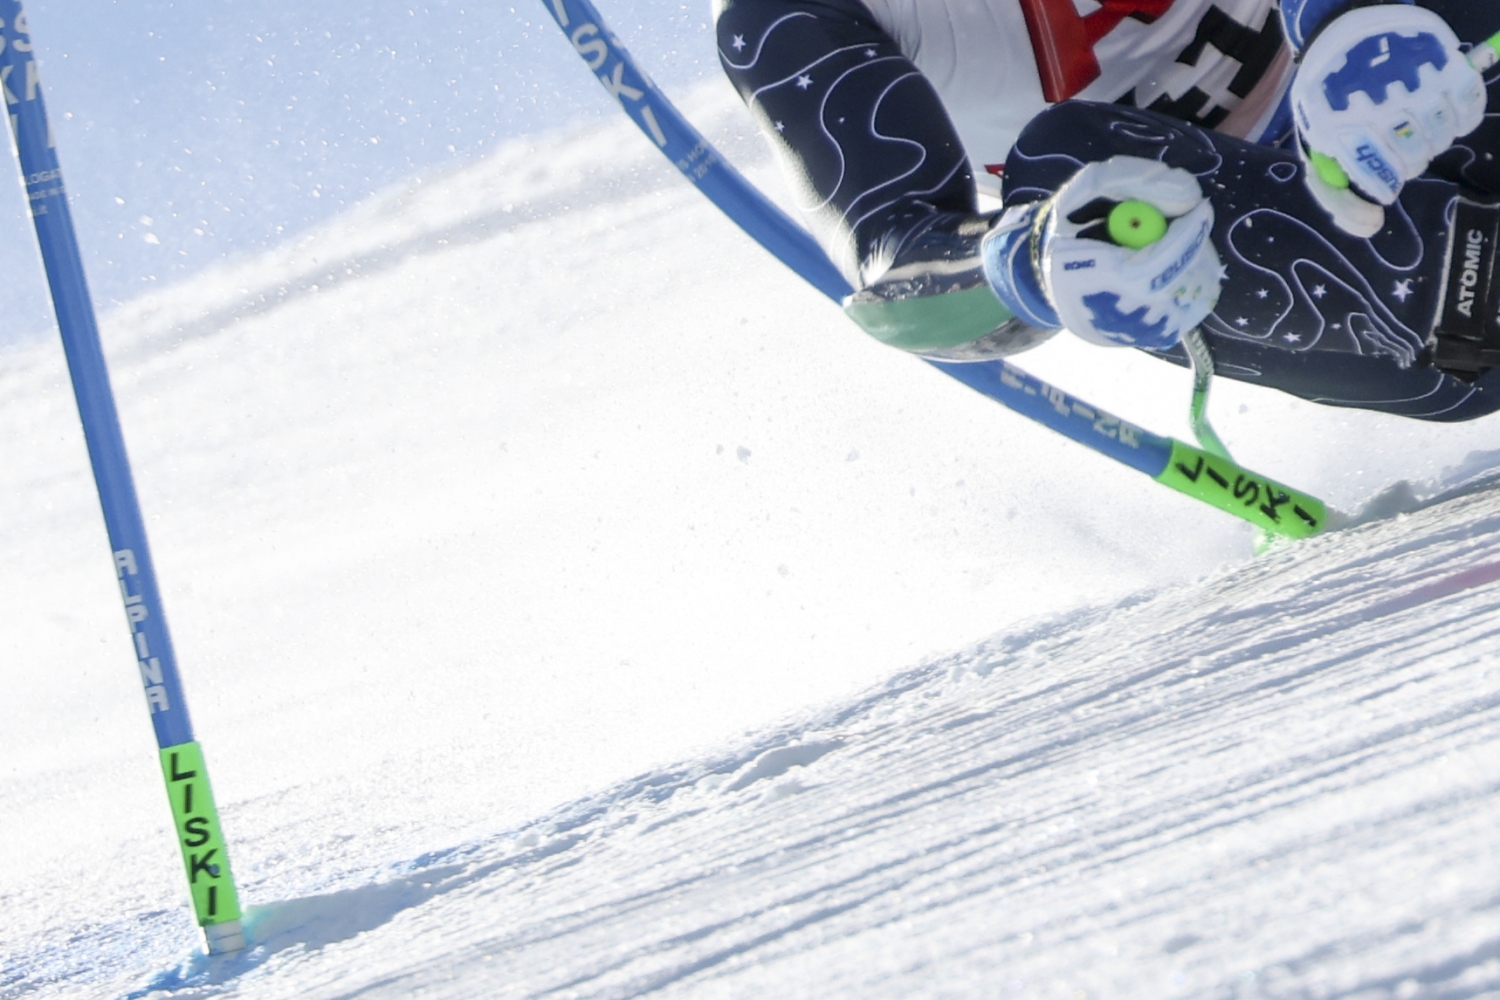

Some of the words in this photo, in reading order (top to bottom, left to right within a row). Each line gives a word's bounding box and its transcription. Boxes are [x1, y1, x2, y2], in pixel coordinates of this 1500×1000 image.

[1457, 229, 1483, 318] ATOMIC
[1175, 456, 1318, 527] LISKI
[113, 549, 170, 715] ALPINA
[170, 751, 221, 917] LISKI
